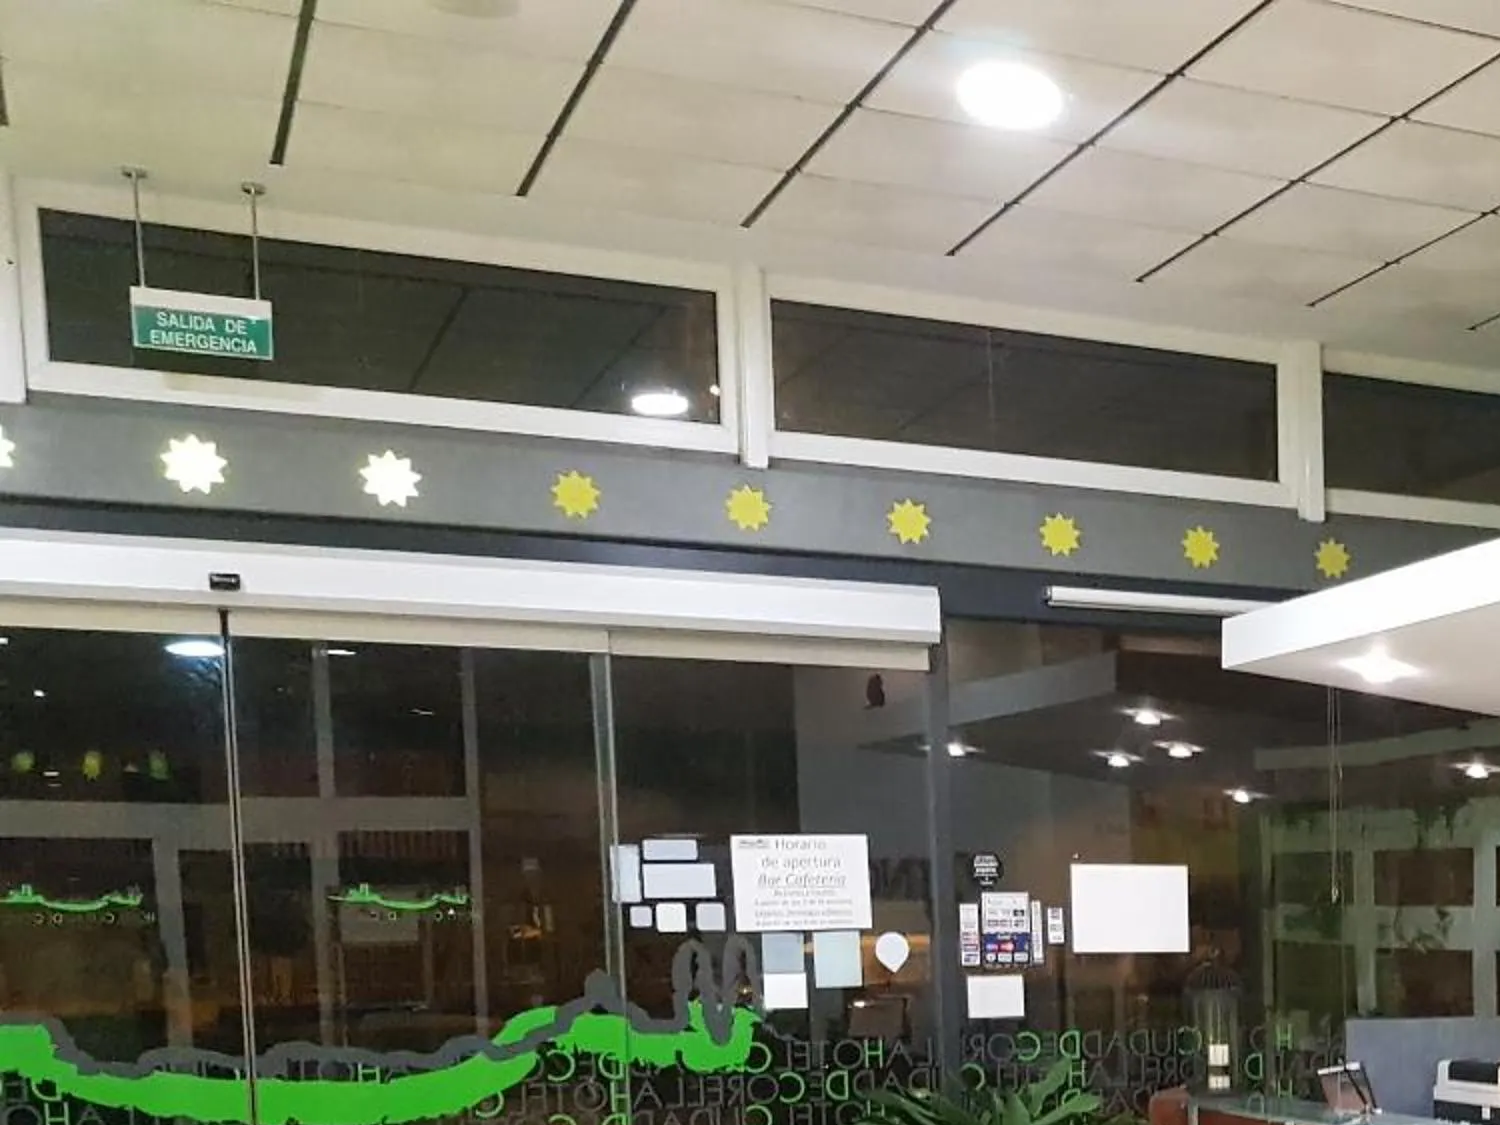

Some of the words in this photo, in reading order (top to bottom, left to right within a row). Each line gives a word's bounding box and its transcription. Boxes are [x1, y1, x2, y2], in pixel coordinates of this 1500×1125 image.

[156, 311, 216, 333] SALIDA
[224, 319, 248, 335] DE
[149, 329, 257, 354] EMERGENCIA
